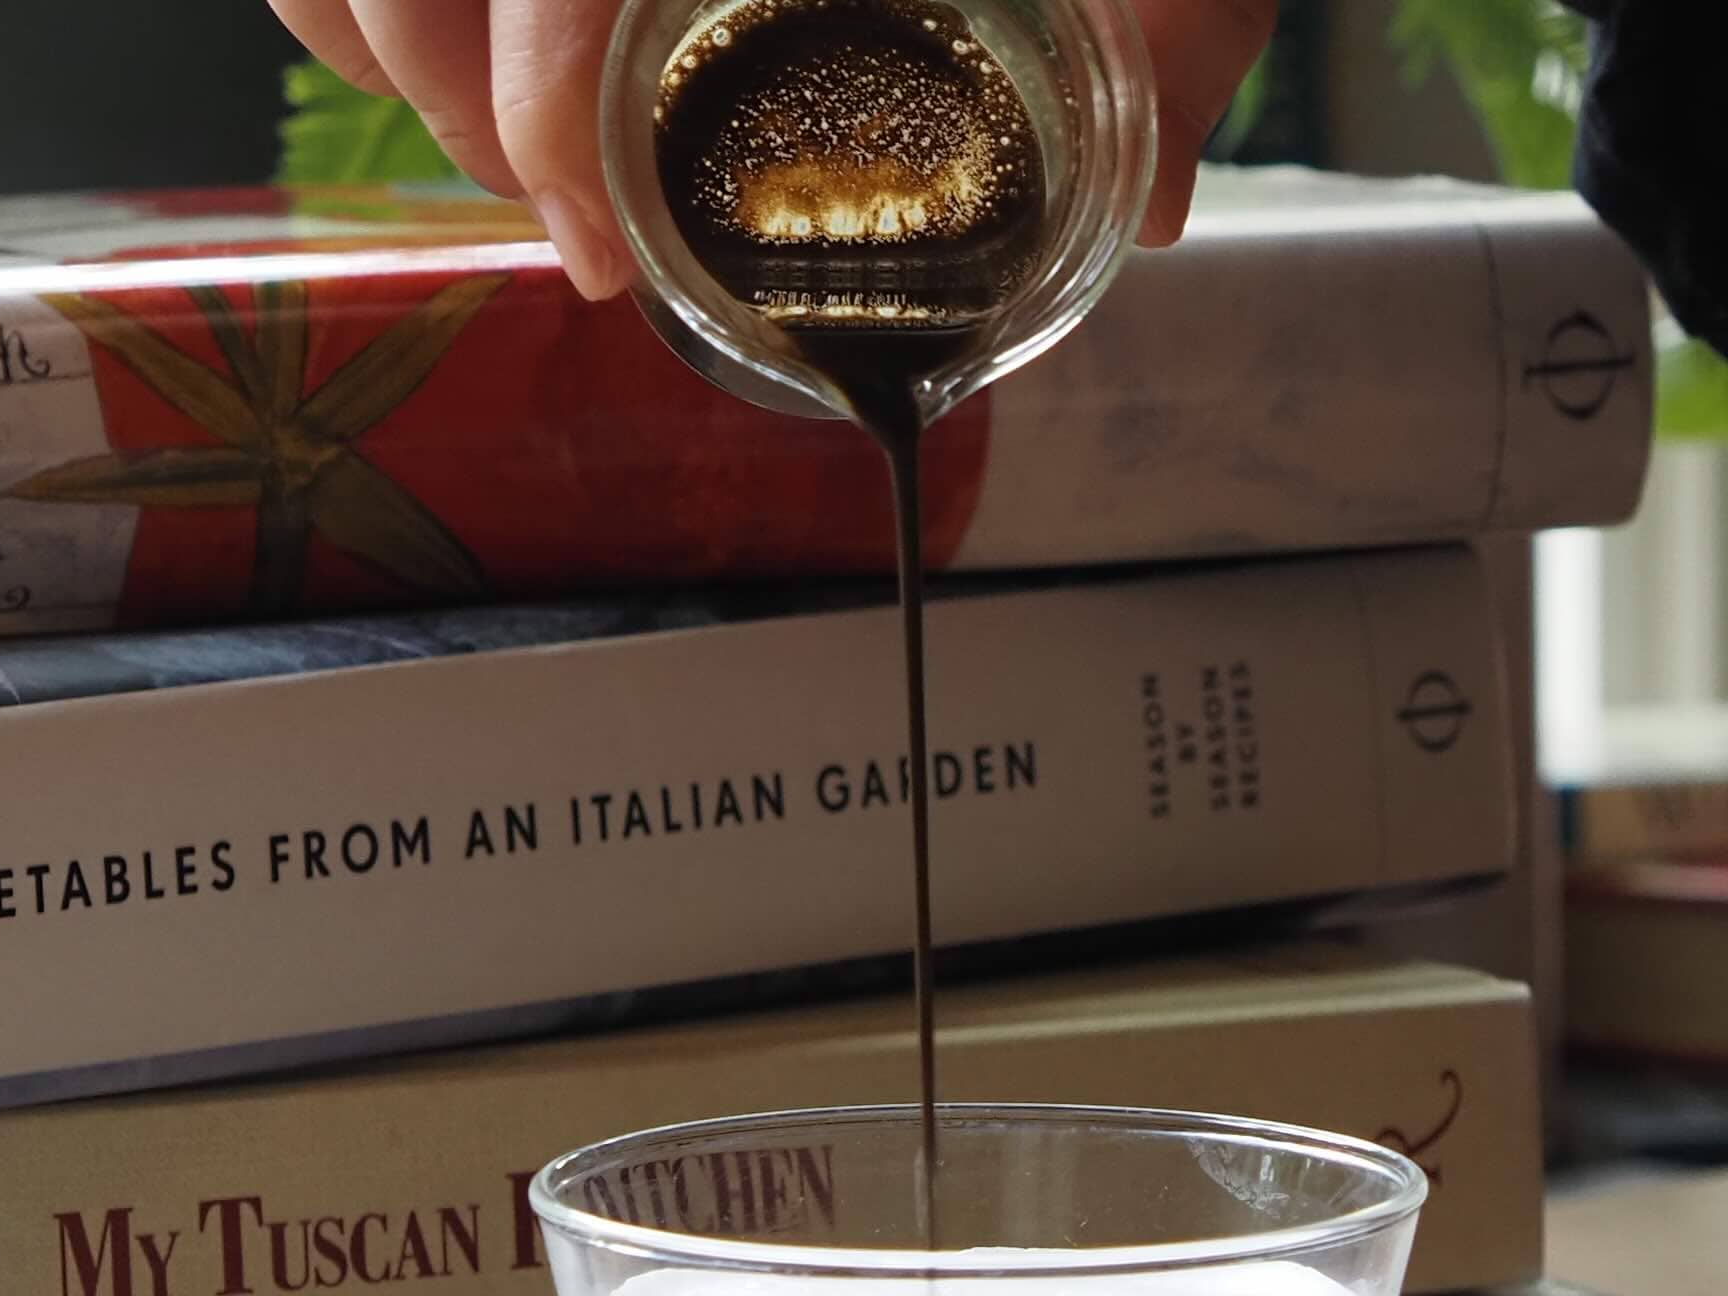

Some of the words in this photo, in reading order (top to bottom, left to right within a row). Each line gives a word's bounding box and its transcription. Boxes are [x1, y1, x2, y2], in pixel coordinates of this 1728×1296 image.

[1140, 673, 1170, 820] SEASON
[1176, 723, 1197, 764] BY
[1202, 667, 1230, 812] SEASON
[1230, 661, 1260, 808] RECIPES
[268, 816, 432, 884] FROM
[464, 803, 539, 860] AN
[570, 772, 786, 846] ITALIAN
